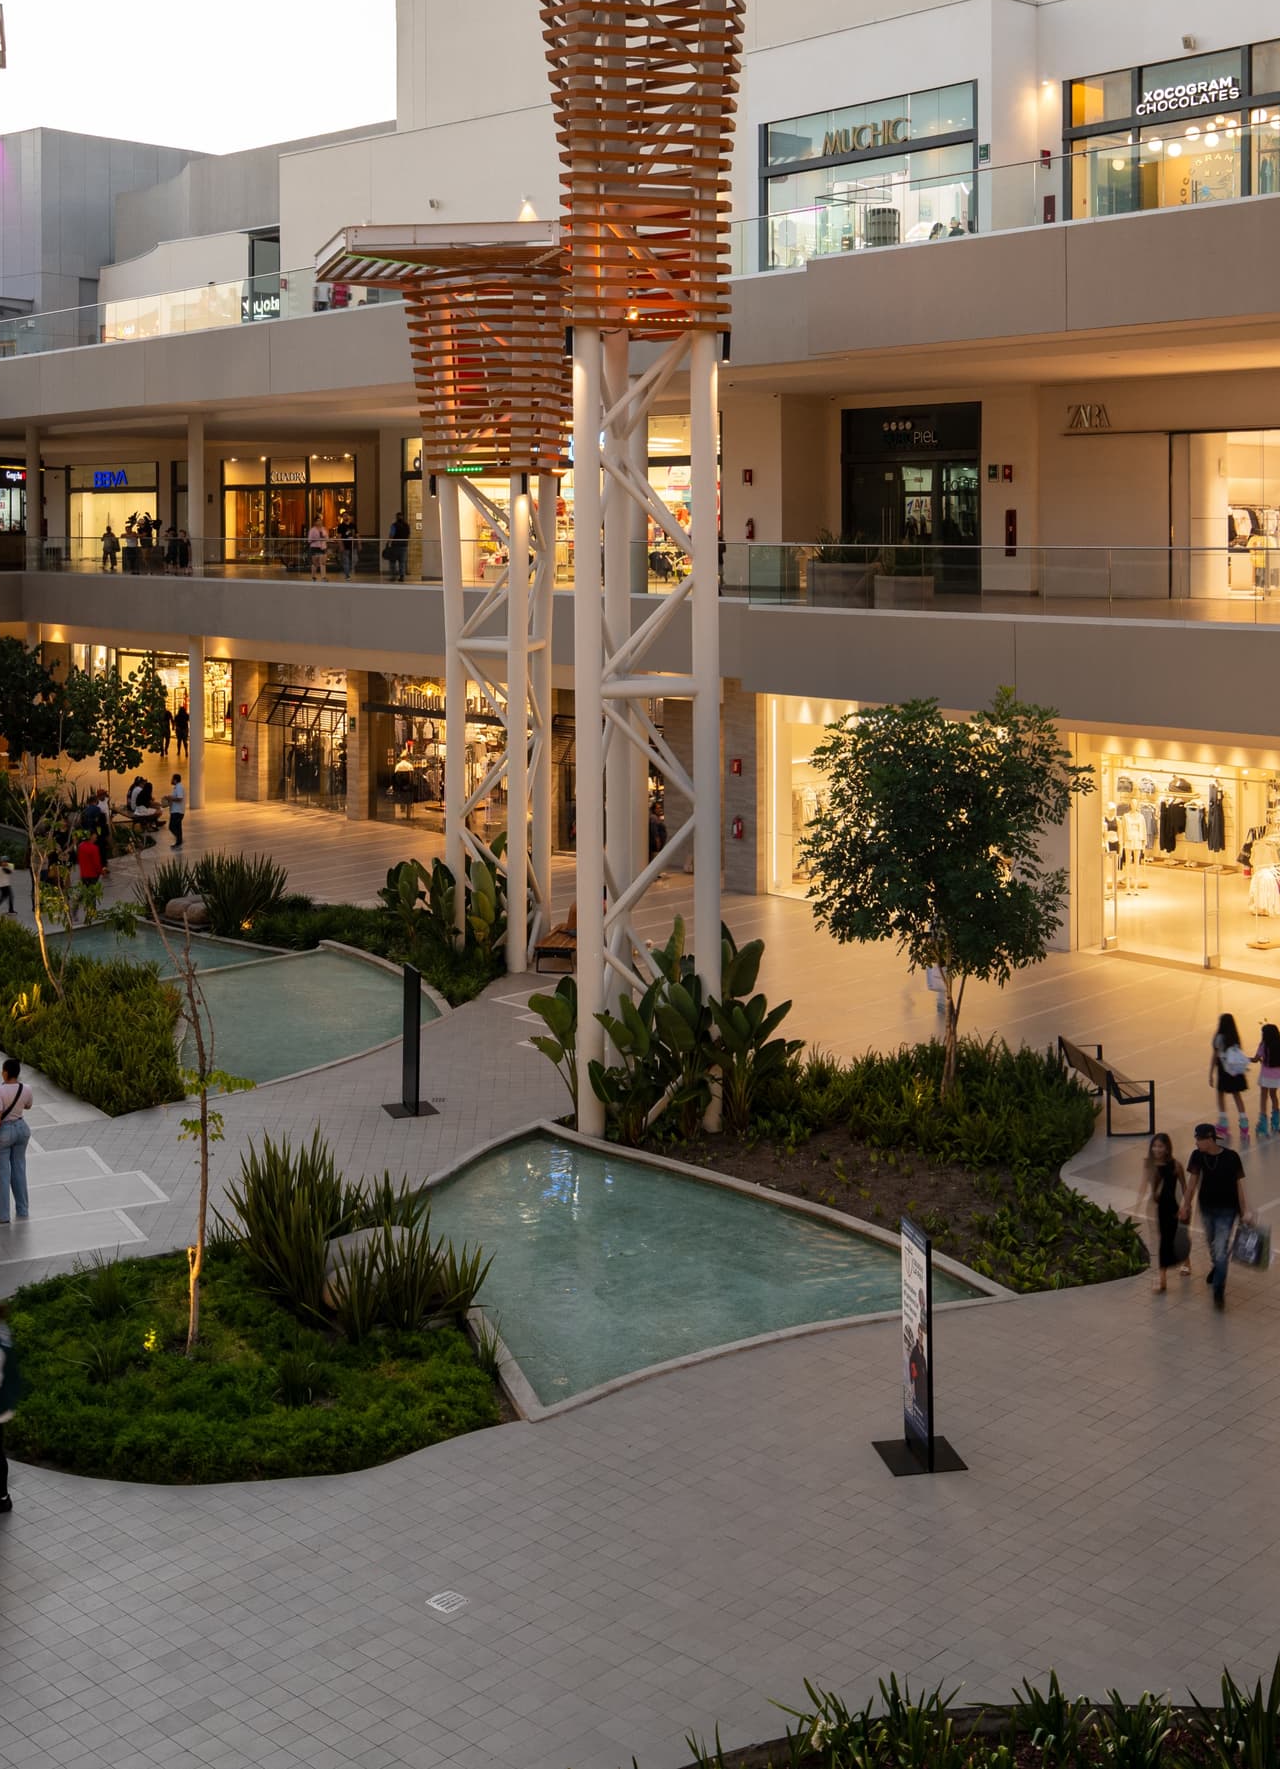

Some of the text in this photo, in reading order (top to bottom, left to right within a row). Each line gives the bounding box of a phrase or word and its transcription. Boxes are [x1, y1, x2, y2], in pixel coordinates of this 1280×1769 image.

[1135, 87, 1240, 116] CHOCOLATES
[1143, 76, 1233, 104] XOCOGRAM
[822, 117, 912, 157] MUCHIC
[1067, 404, 1112, 429] ZARA
[93, 469, 128, 488] BBVA
